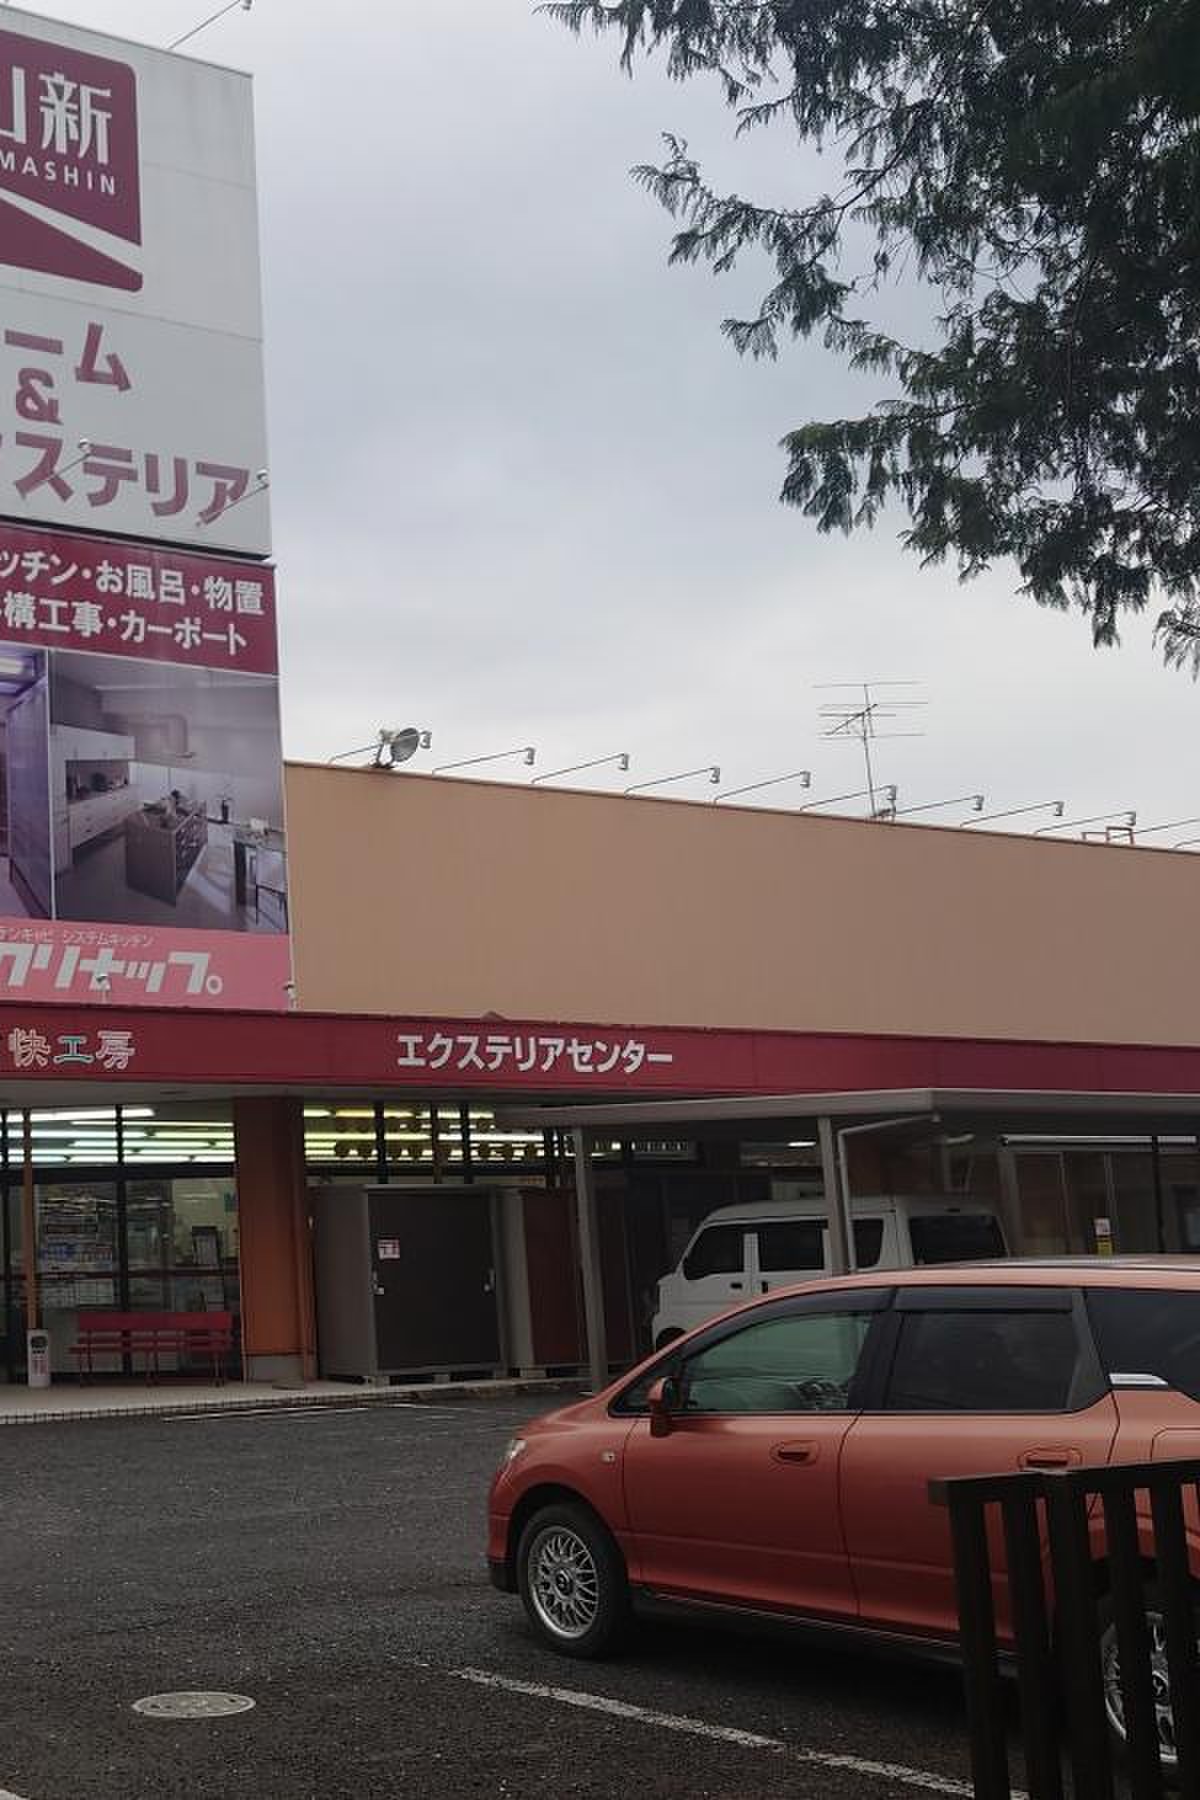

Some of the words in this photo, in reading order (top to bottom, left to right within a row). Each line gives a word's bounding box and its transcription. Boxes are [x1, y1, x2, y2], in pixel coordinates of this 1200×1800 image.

[15, 367, 62, 425] &
[397, 1032, 674, 1073] エクステリアセンター
